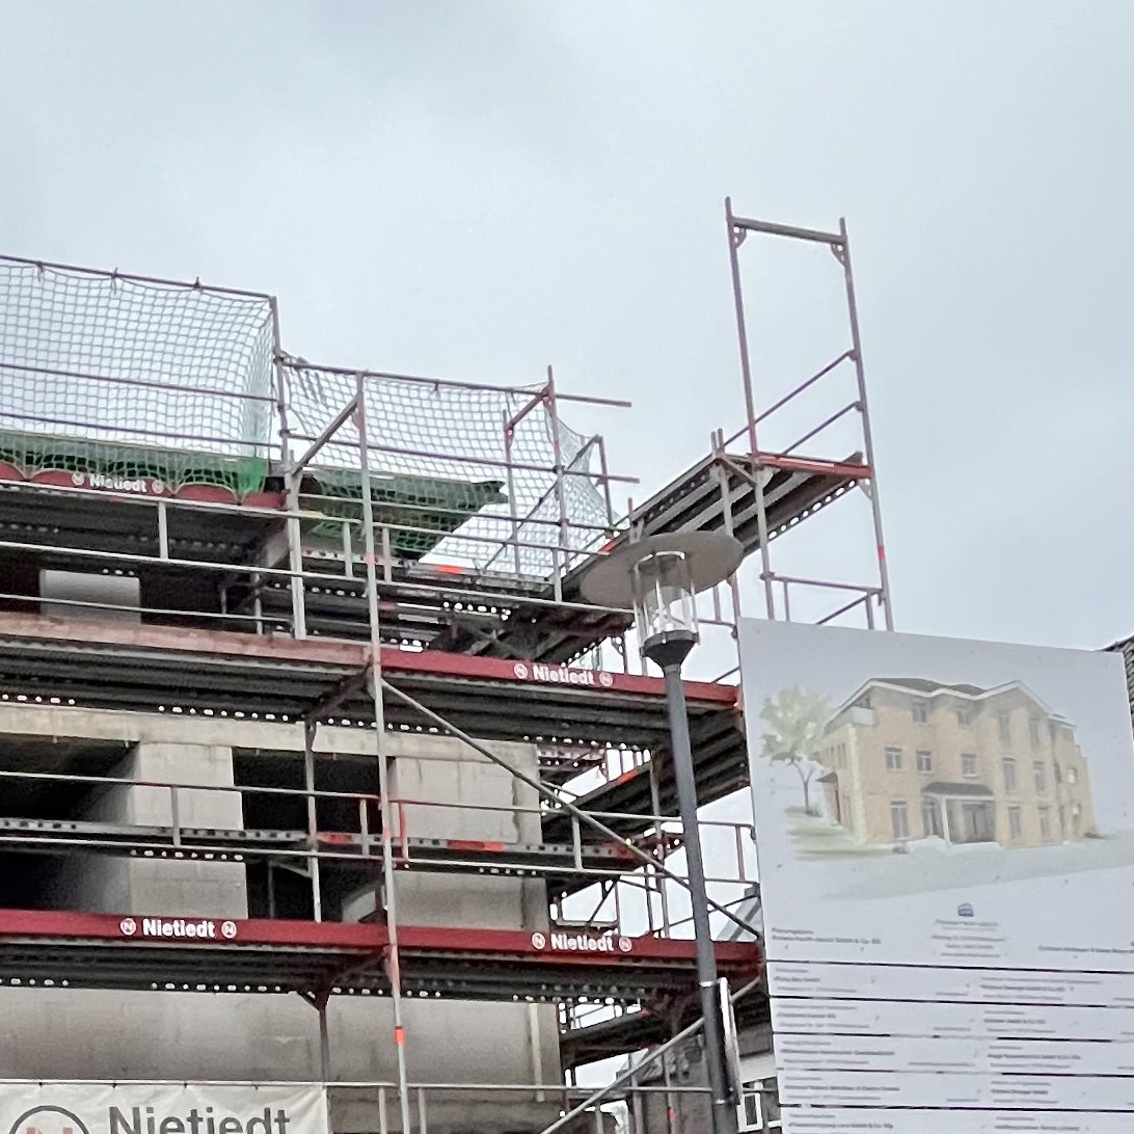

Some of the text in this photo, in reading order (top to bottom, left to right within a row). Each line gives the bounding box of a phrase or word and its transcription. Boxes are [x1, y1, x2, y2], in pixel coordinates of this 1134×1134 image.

[532, 665, 596, 686] Nietiedt
[142, 918, 215, 937] Nietiedt
[551, 934, 614, 952] Nietiedt
